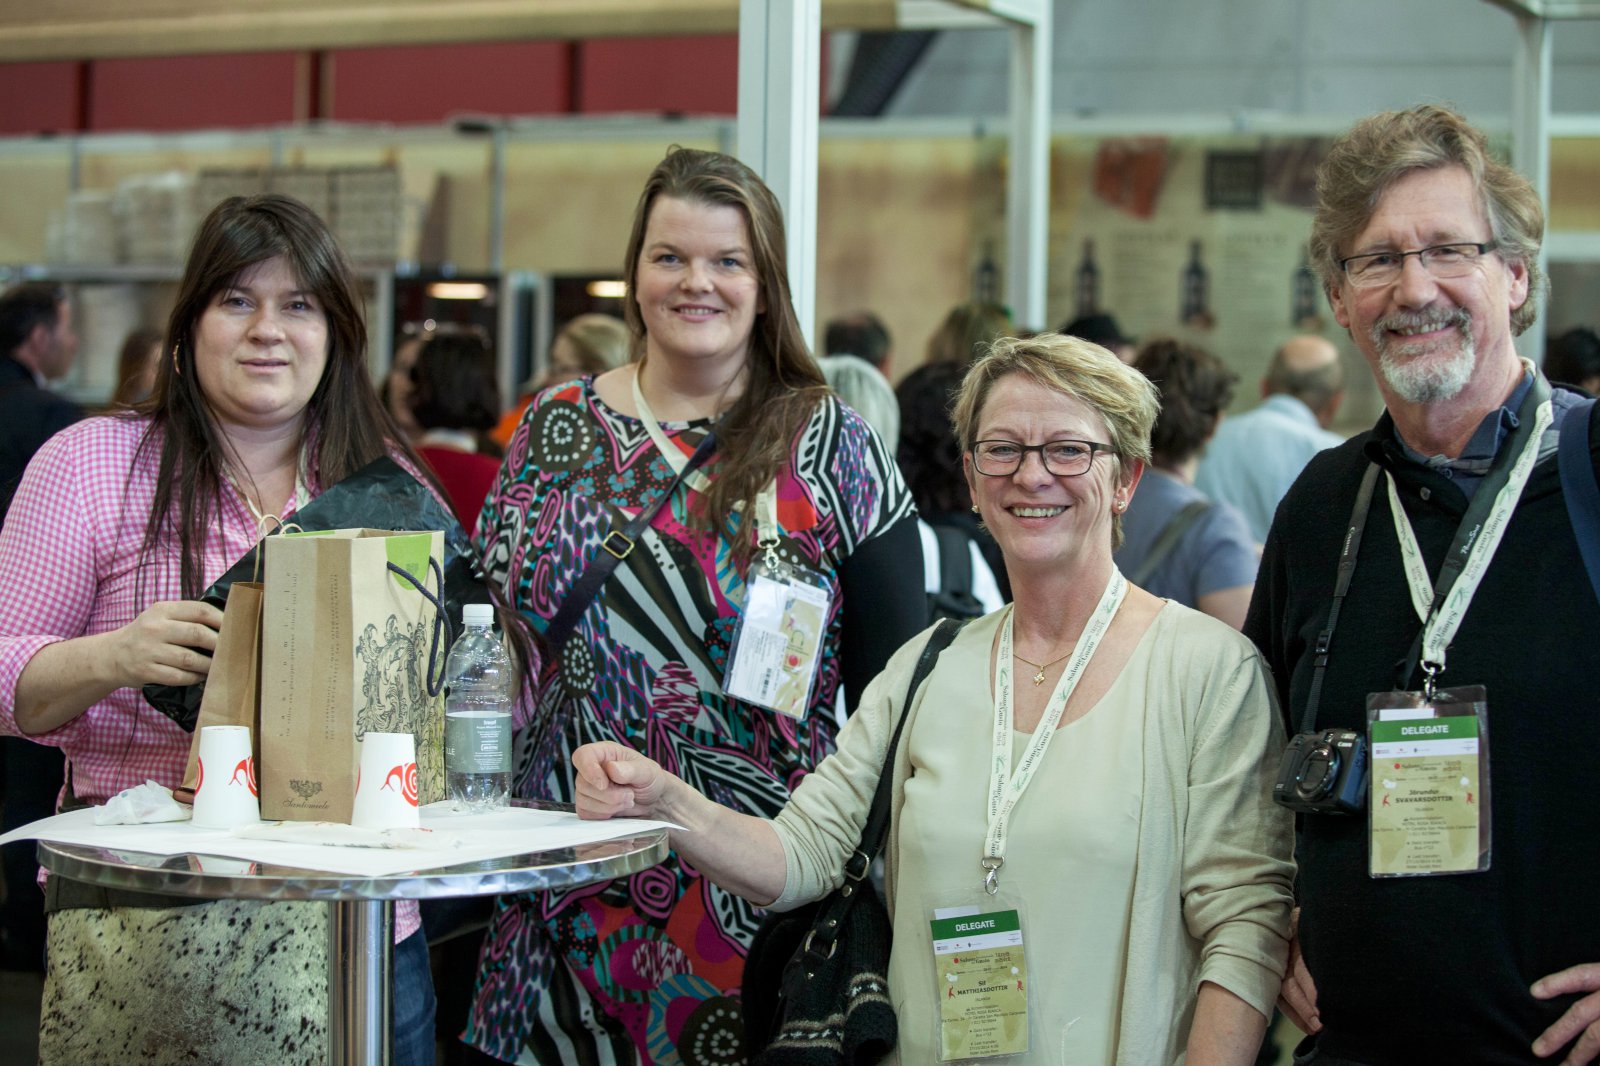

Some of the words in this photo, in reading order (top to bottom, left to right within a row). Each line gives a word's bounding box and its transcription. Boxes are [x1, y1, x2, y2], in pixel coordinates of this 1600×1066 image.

[1490, 508, 1506, 534] Salone
[1067, 657, 1083, 681] Salone
[1401, 725, 1449, 736] DELEGATE
[1037, 731, 1051, 751] Gusto
[1022, 748, 1038, 772] Salone
[955, 919, 996, 932] DELEGATE
[957, 985, 1009, 995] MATTHIASDOTTIR
